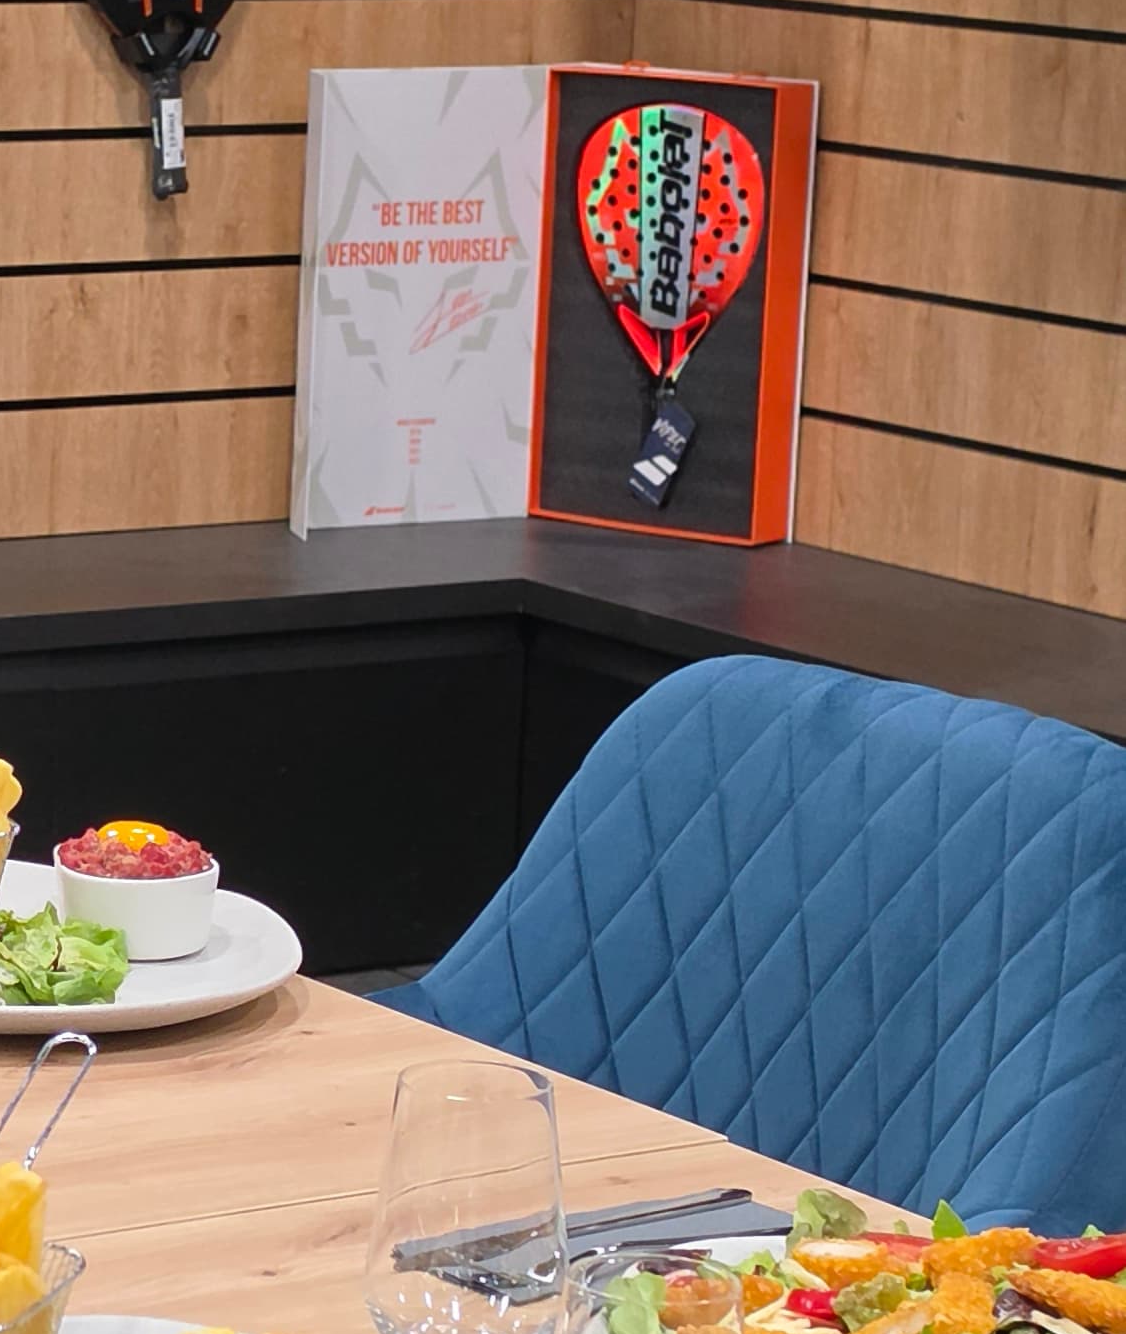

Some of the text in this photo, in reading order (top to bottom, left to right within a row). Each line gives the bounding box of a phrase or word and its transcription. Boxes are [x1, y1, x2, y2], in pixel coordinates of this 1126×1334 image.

[407, 201, 439, 226] THE
[442, 199, 485, 225] BEST
[650, 109, 692, 318] Babolat
[327, 241, 399, 267] VERSION
[403, 240, 425, 265] OF
